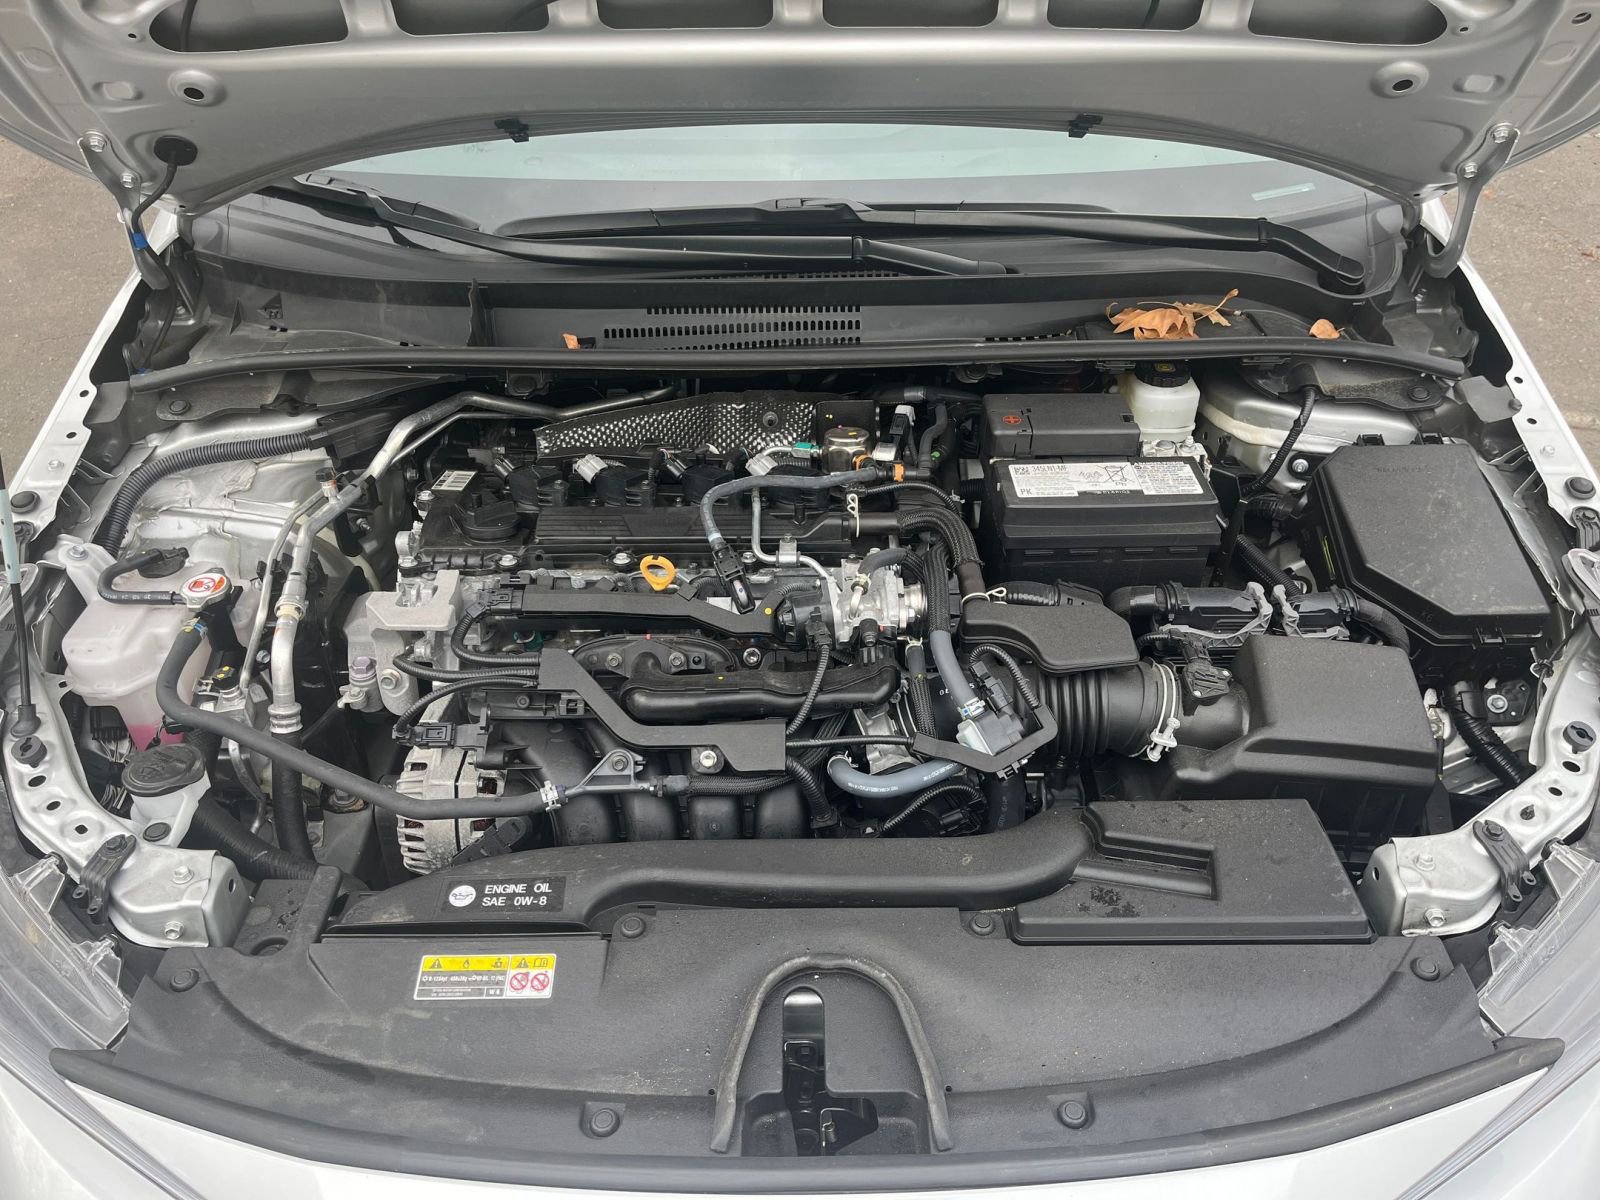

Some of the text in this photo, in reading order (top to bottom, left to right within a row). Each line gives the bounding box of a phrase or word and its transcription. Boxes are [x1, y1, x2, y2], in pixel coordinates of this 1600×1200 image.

[485, 883, 553, 894] ENGINE OIL
[482, 896, 547, 906] SAE 0W-8
